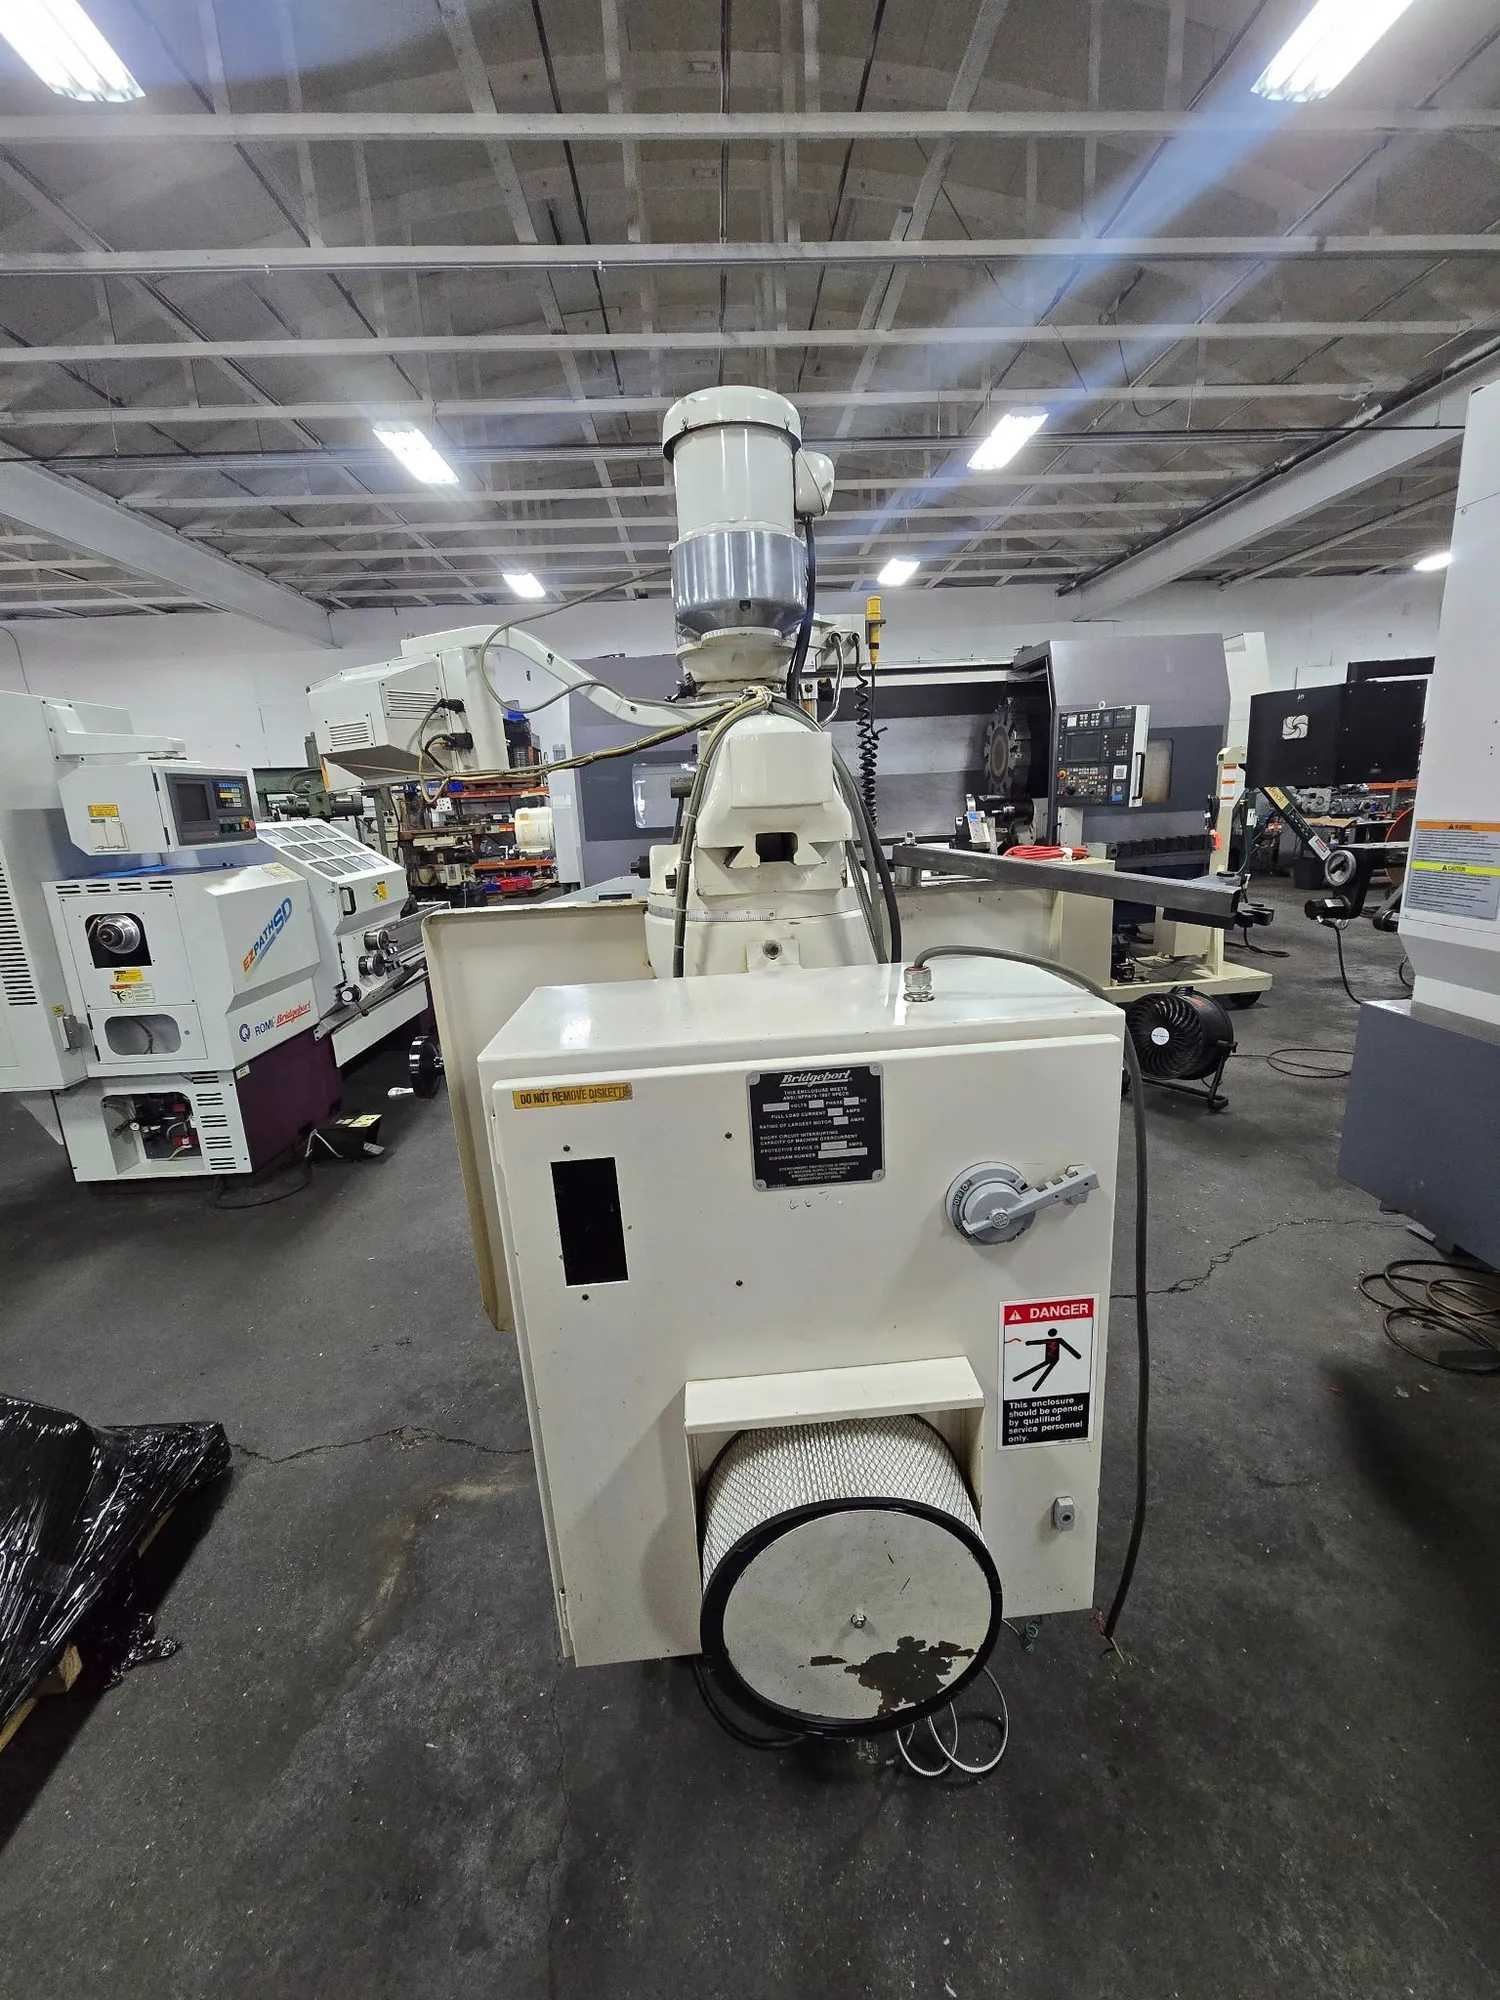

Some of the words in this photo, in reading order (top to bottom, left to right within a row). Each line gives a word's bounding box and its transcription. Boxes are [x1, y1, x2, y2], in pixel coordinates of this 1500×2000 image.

[276, 1001, 311, 1028] Bridgeport
[780, 1070, 851, 1087] Bridgeport
[520, 1094, 532, 1104] DO
[534, 1092, 549, 1103] NOT
[552, 1089, 587, 1102] REMOVE
[1030, 1303, 1088, 1319] DANGER
[1009, 1401, 1028, 1409] This
[1032, 1398, 1074, 1407] enclosure
[1009, 1408, 1037, 1418] should
[1040, 1406, 1050, 1414] be
[1052, 1404, 1084, 1415] opened
[1008, 1426, 1038, 1434] service
[1042, 1420, 1083, 1432] personnel
[1009, 1420, 1019, 1428] by
[1023, 1415, 1061, 1426] qualified
[1008, 1435, 1029, 1443] only.
